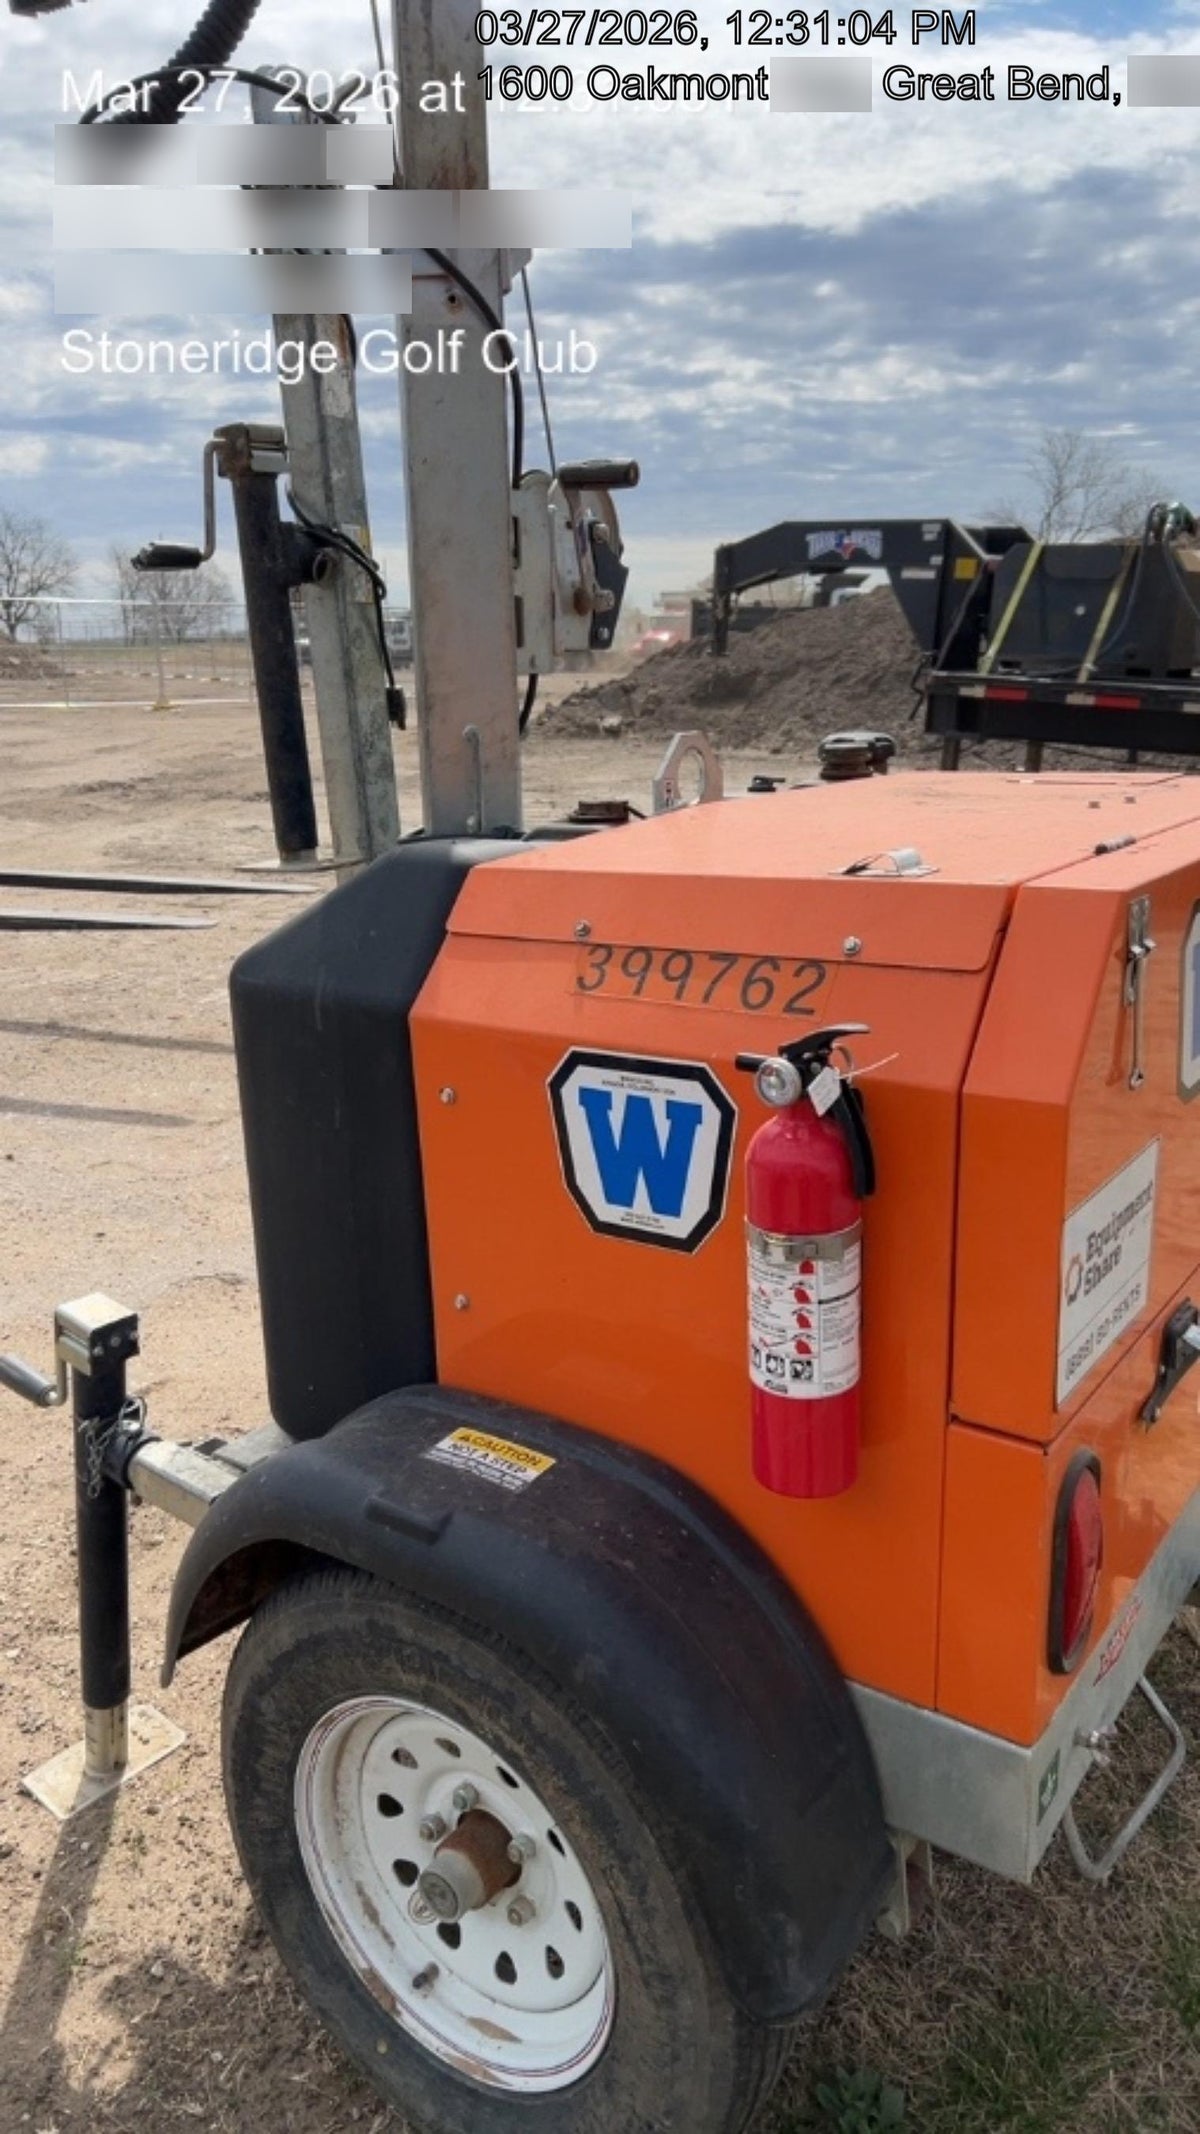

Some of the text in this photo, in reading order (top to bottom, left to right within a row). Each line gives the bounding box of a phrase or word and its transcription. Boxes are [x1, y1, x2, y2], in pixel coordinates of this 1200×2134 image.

[576, 943, 827, 1016] 399762
[578, 1086, 703, 1219] W
[1085, 1180, 1154, 1262] Equipment
[1083, 1243, 1123, 1297] Share
[471, 1435, 542, 1466] CAUTION
